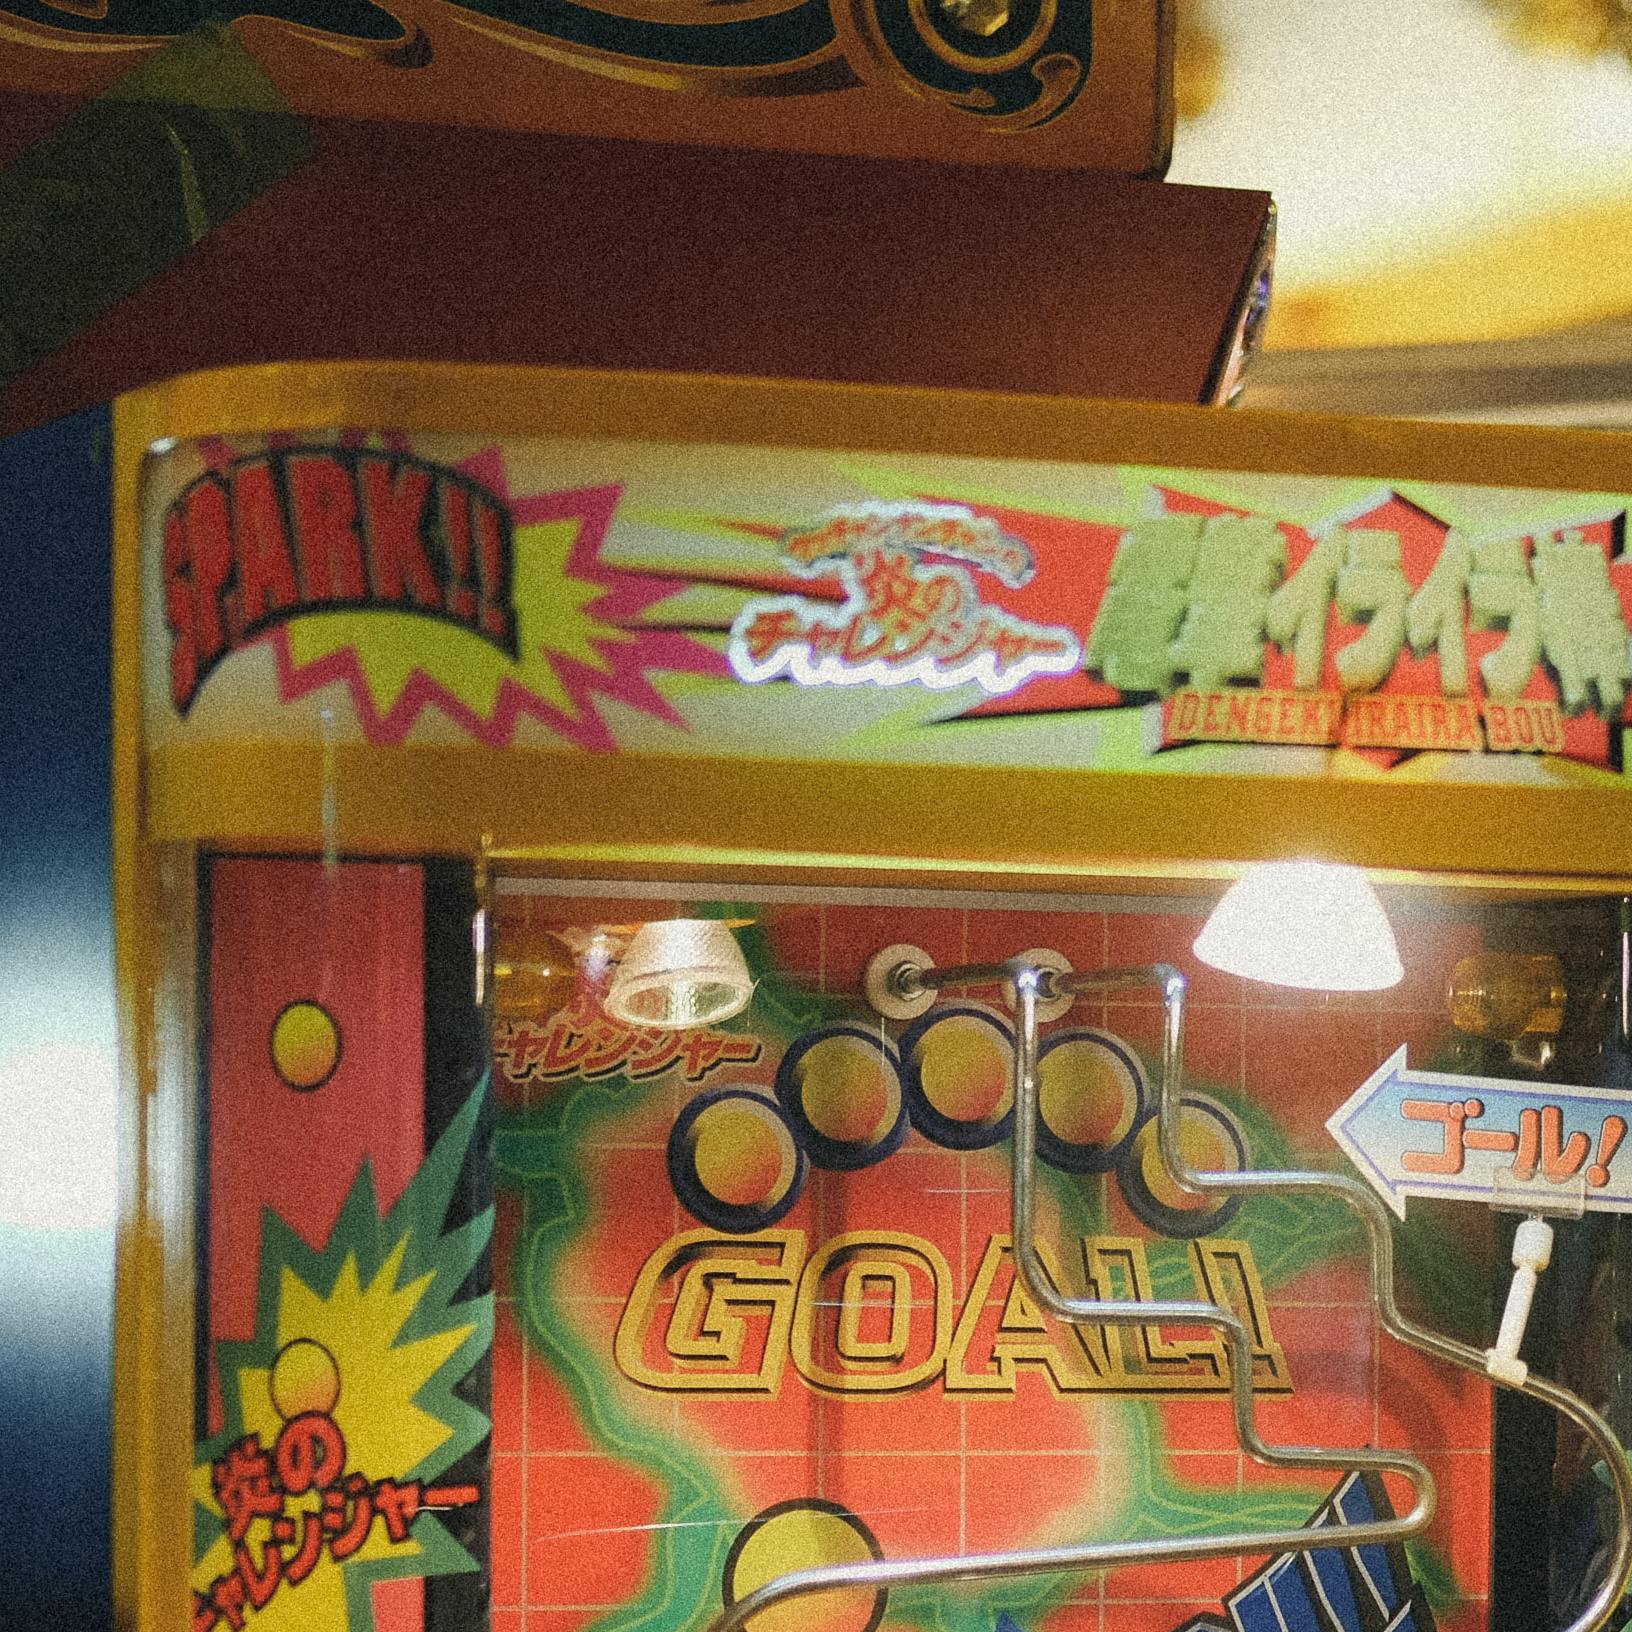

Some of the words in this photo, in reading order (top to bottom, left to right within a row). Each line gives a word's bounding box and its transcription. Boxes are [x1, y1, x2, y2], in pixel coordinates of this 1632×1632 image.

[1486, 700, 1566, 752] BOU
[1401, 1097, 1628, 1188] ゴール!
